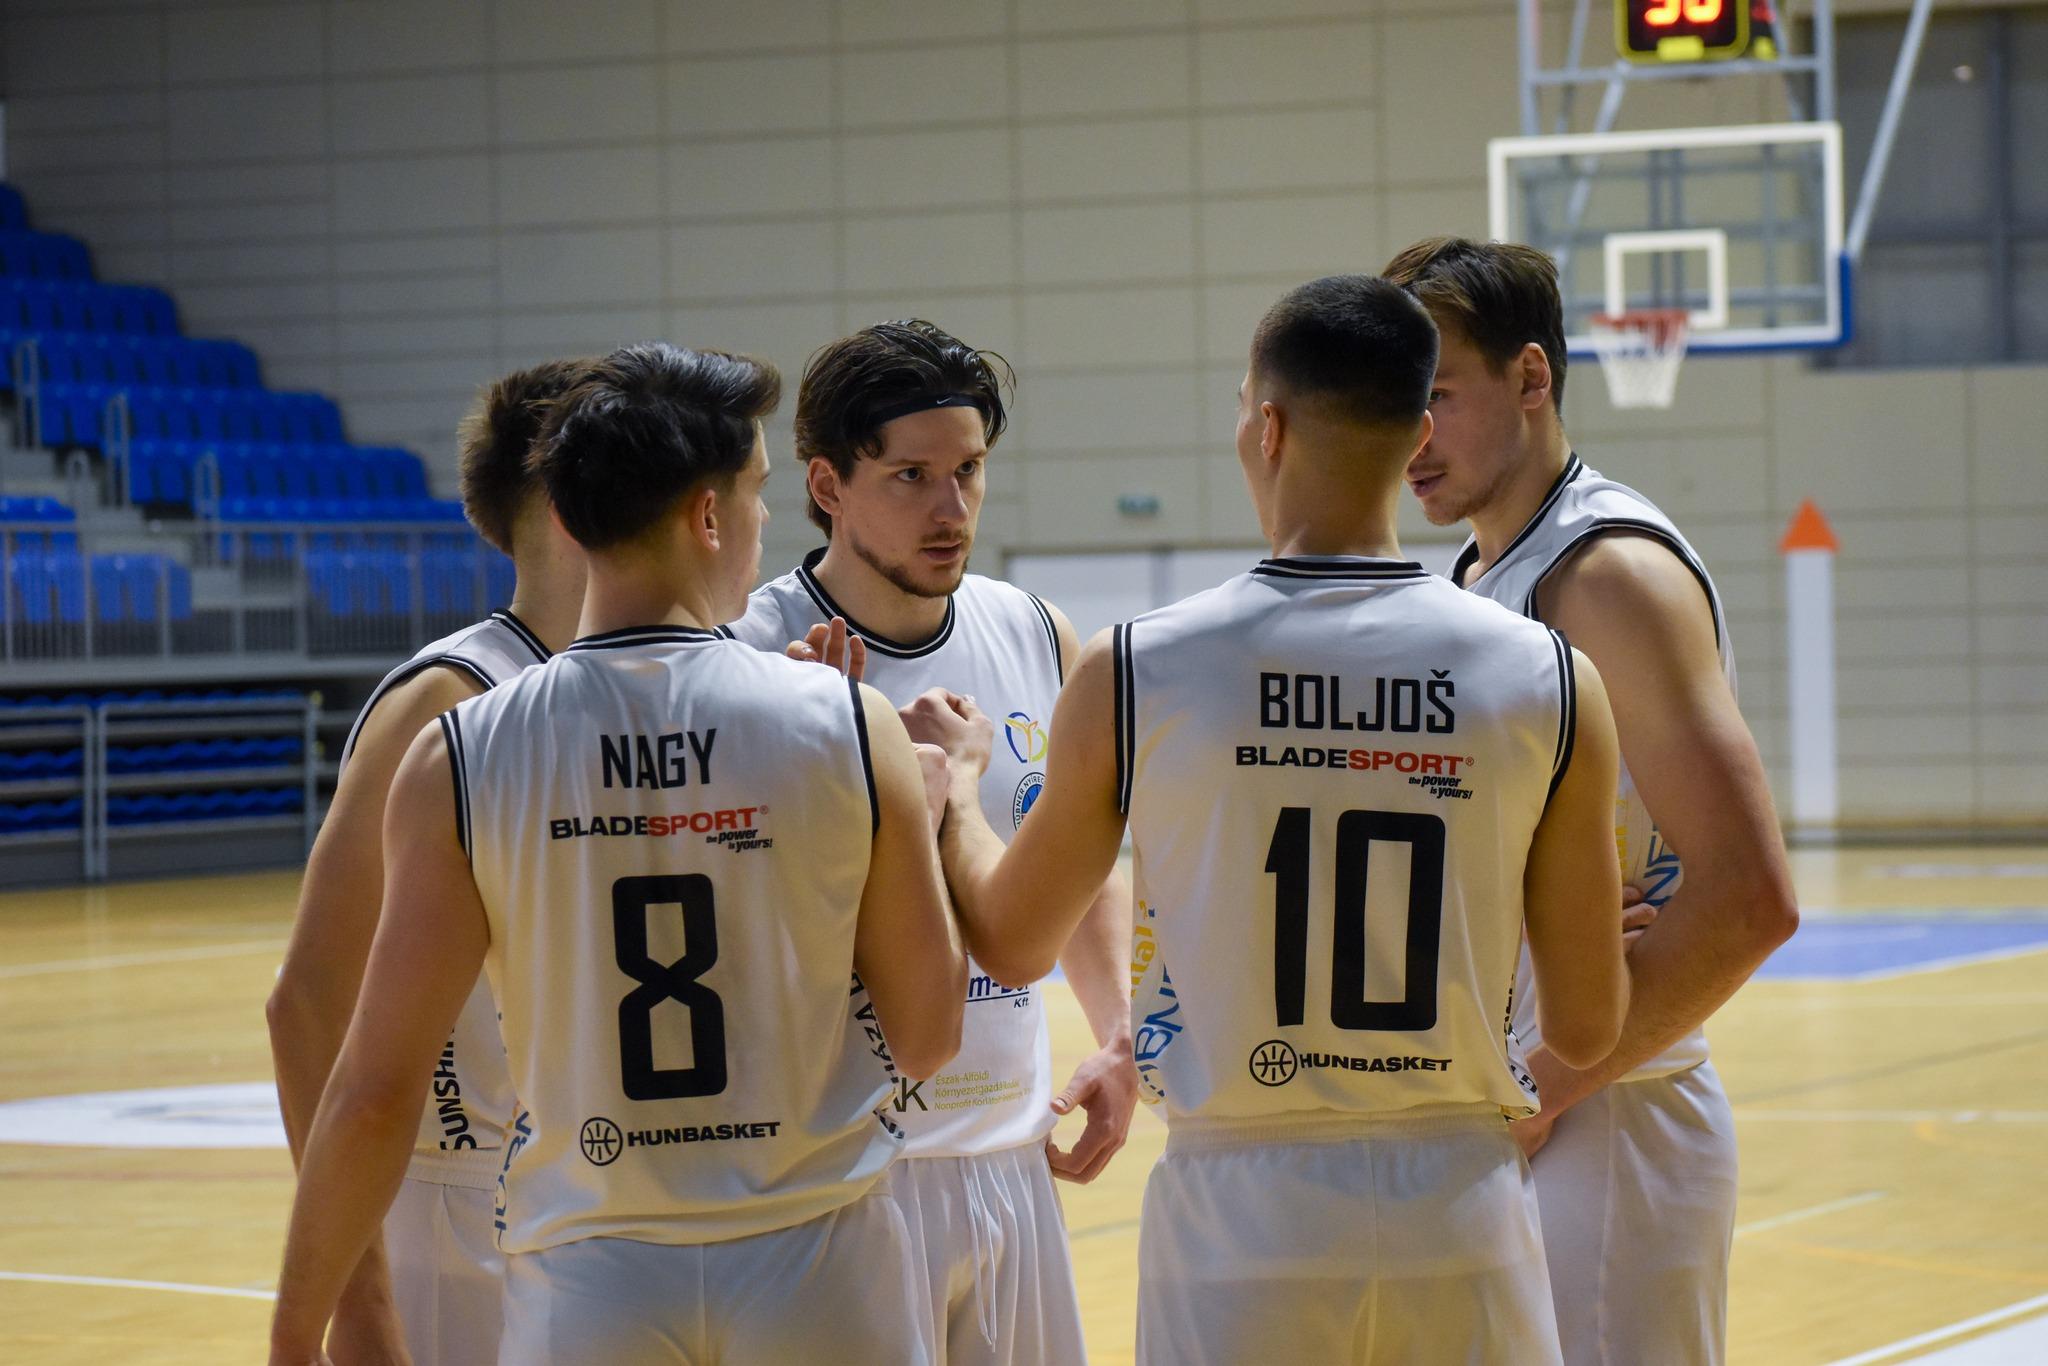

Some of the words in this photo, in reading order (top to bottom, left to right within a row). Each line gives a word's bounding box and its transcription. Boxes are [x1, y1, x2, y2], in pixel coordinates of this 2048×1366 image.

[1260, 669, 1455, 734] BOLJOŠ
[600, 728, 717, 789] NAGY
[1408, 776, 1421, 785] the
[1421, 775, 1462, 787] power
[1430, 786, 1437, 794] is
[1437, 786, 1473, 799] yours!
[718, 829, 758, 844] power
[735, 838, 773, 853] yours!
[1264, 807, 1446, 1031] 10
[612, 873, 728, 1101] 8
[1299, 1053, 1453, 1072] HUNBASKET
[627, 1122, 780, 1147] HUNBASKET
